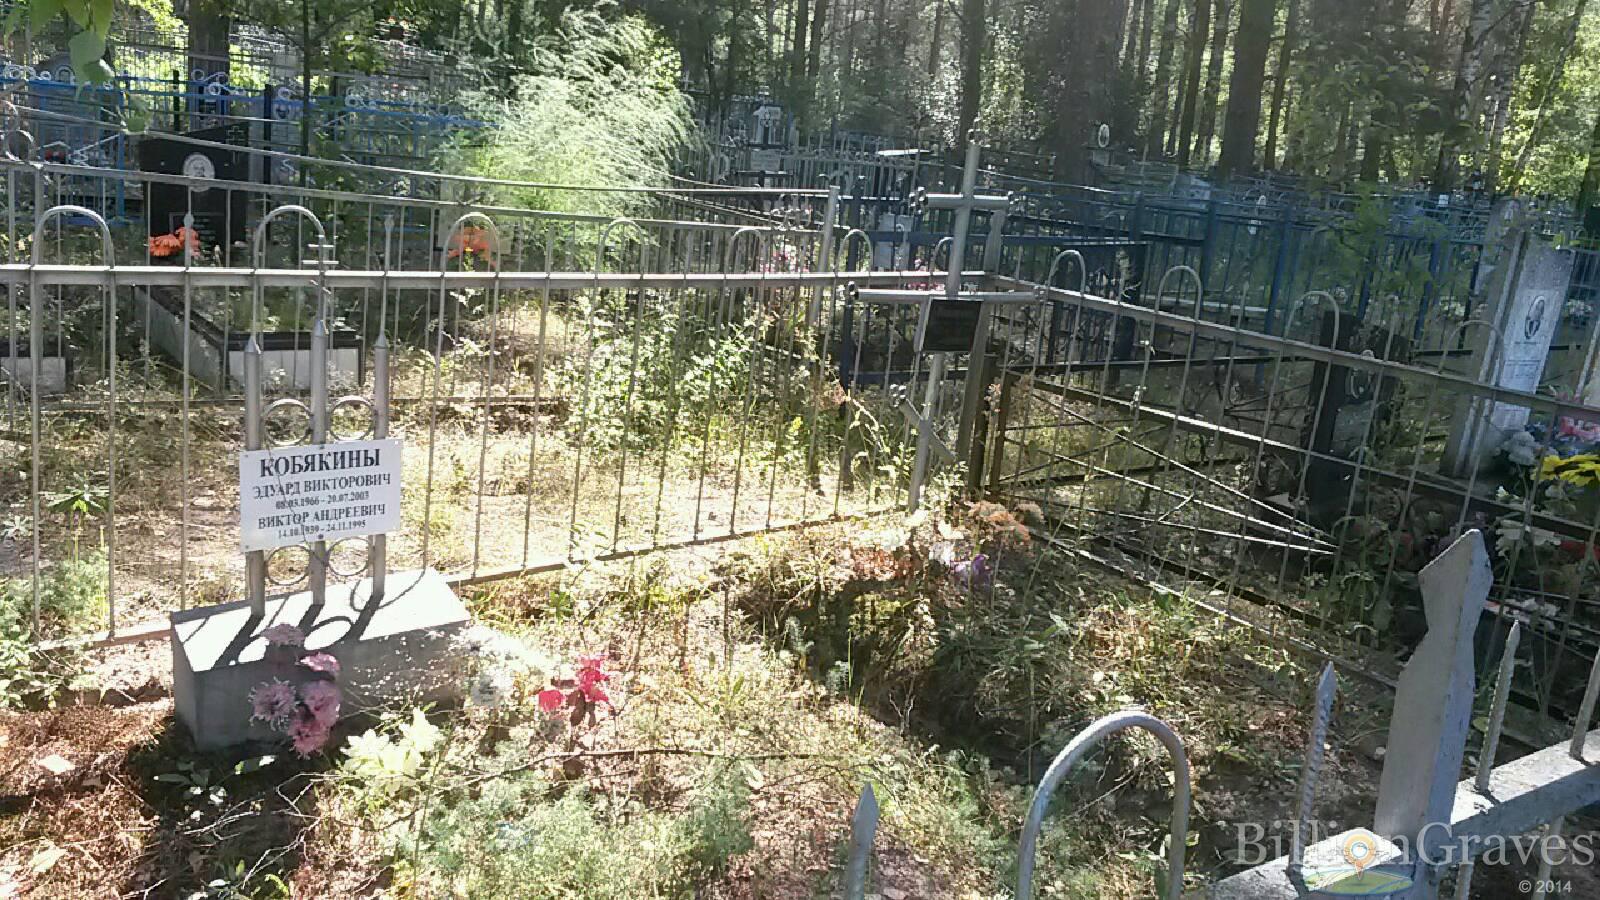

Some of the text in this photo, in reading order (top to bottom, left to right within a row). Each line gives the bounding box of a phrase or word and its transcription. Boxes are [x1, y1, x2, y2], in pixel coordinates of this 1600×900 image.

[260, 449, 380, 477] КОБЯКИНЫ
[253, 473, 391, 499] ЭДУАРД ВИКТОРОВИЧ
[258, 504, 386, 529] ВИКТОР АНДРЕЕВИЧ
